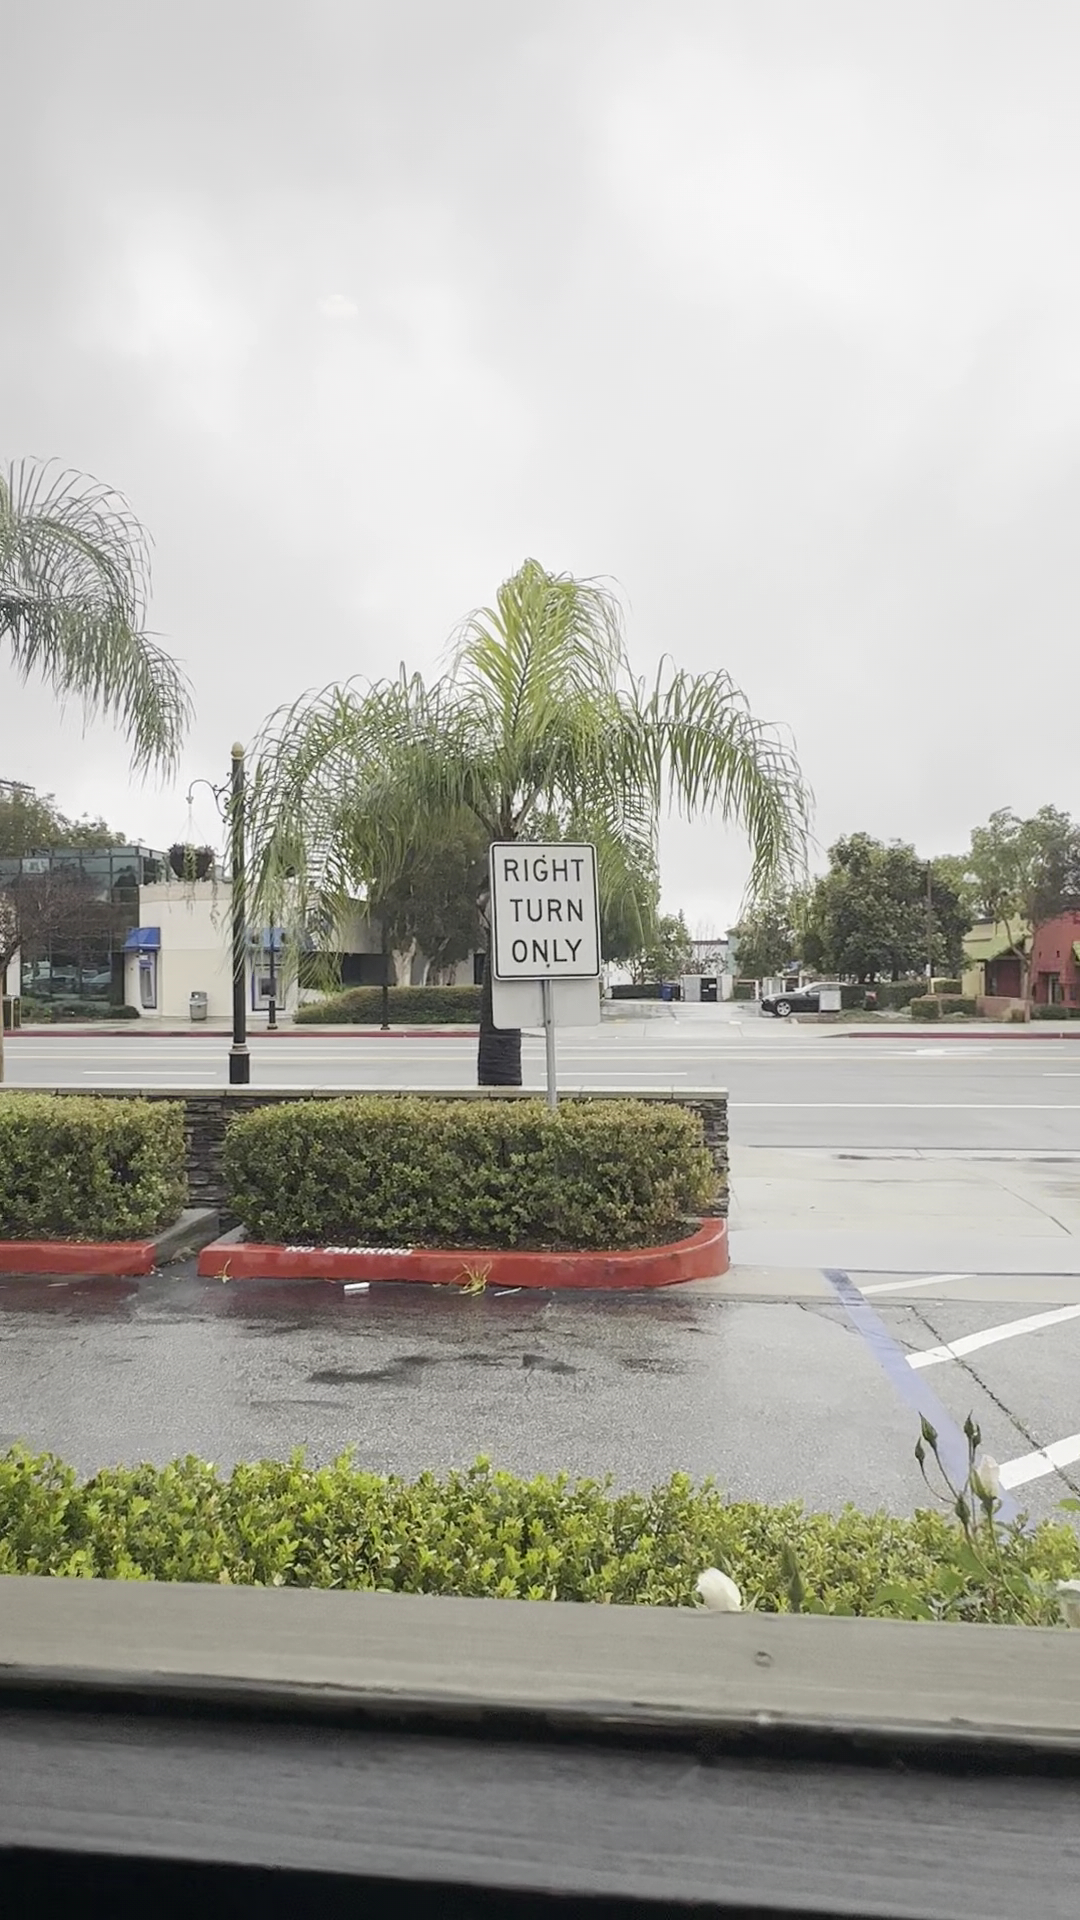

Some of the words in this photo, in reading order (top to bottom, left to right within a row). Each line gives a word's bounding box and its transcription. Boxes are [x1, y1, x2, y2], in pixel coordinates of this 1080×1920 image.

[504, 859, 584, 881] RIGHT
[510, 899, 583, 922] TURN
[512, 939, 582, 963] ONLY
[323, 1246, 413, 1256] PARKING
